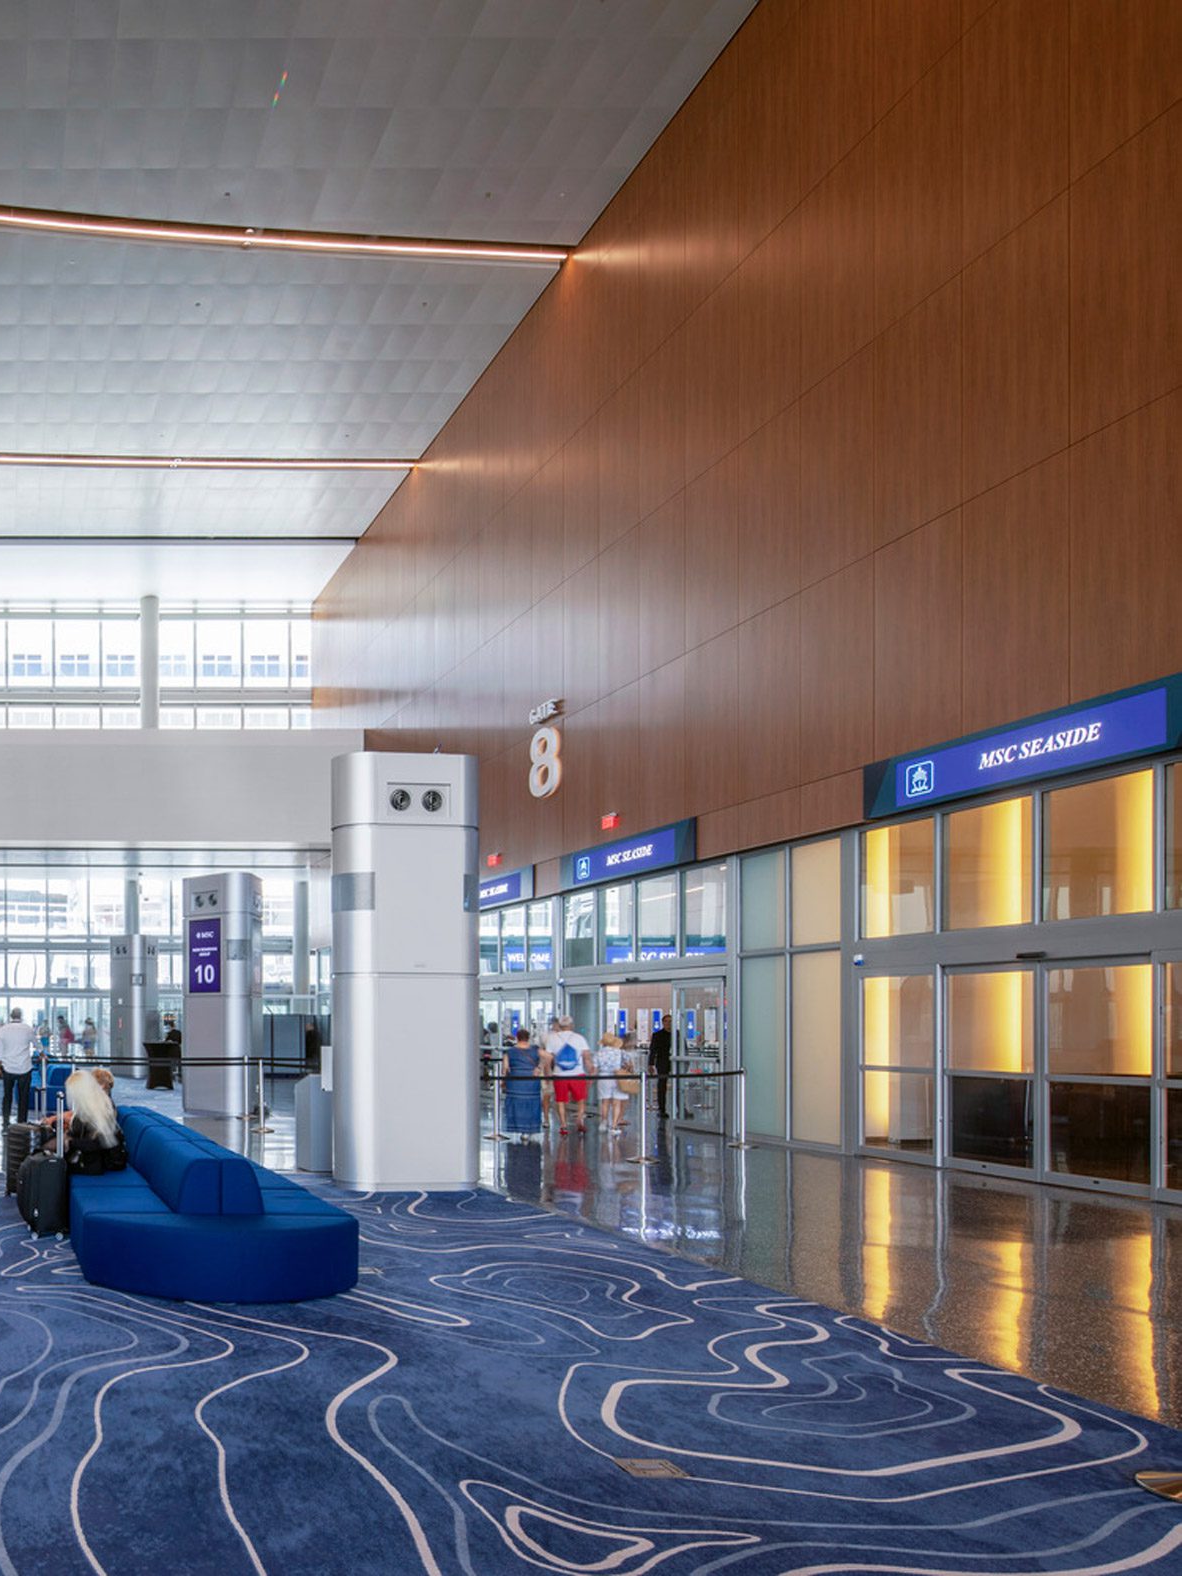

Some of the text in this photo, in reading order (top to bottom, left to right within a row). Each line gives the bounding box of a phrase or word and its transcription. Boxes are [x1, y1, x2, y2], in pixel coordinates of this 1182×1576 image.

[529, 699, 559, 725] GATE
[529, 727, 562, 798] 8
[978, 722, 1102, 770] MSC SEASIDE
[194, 964, 215, 983] 10
